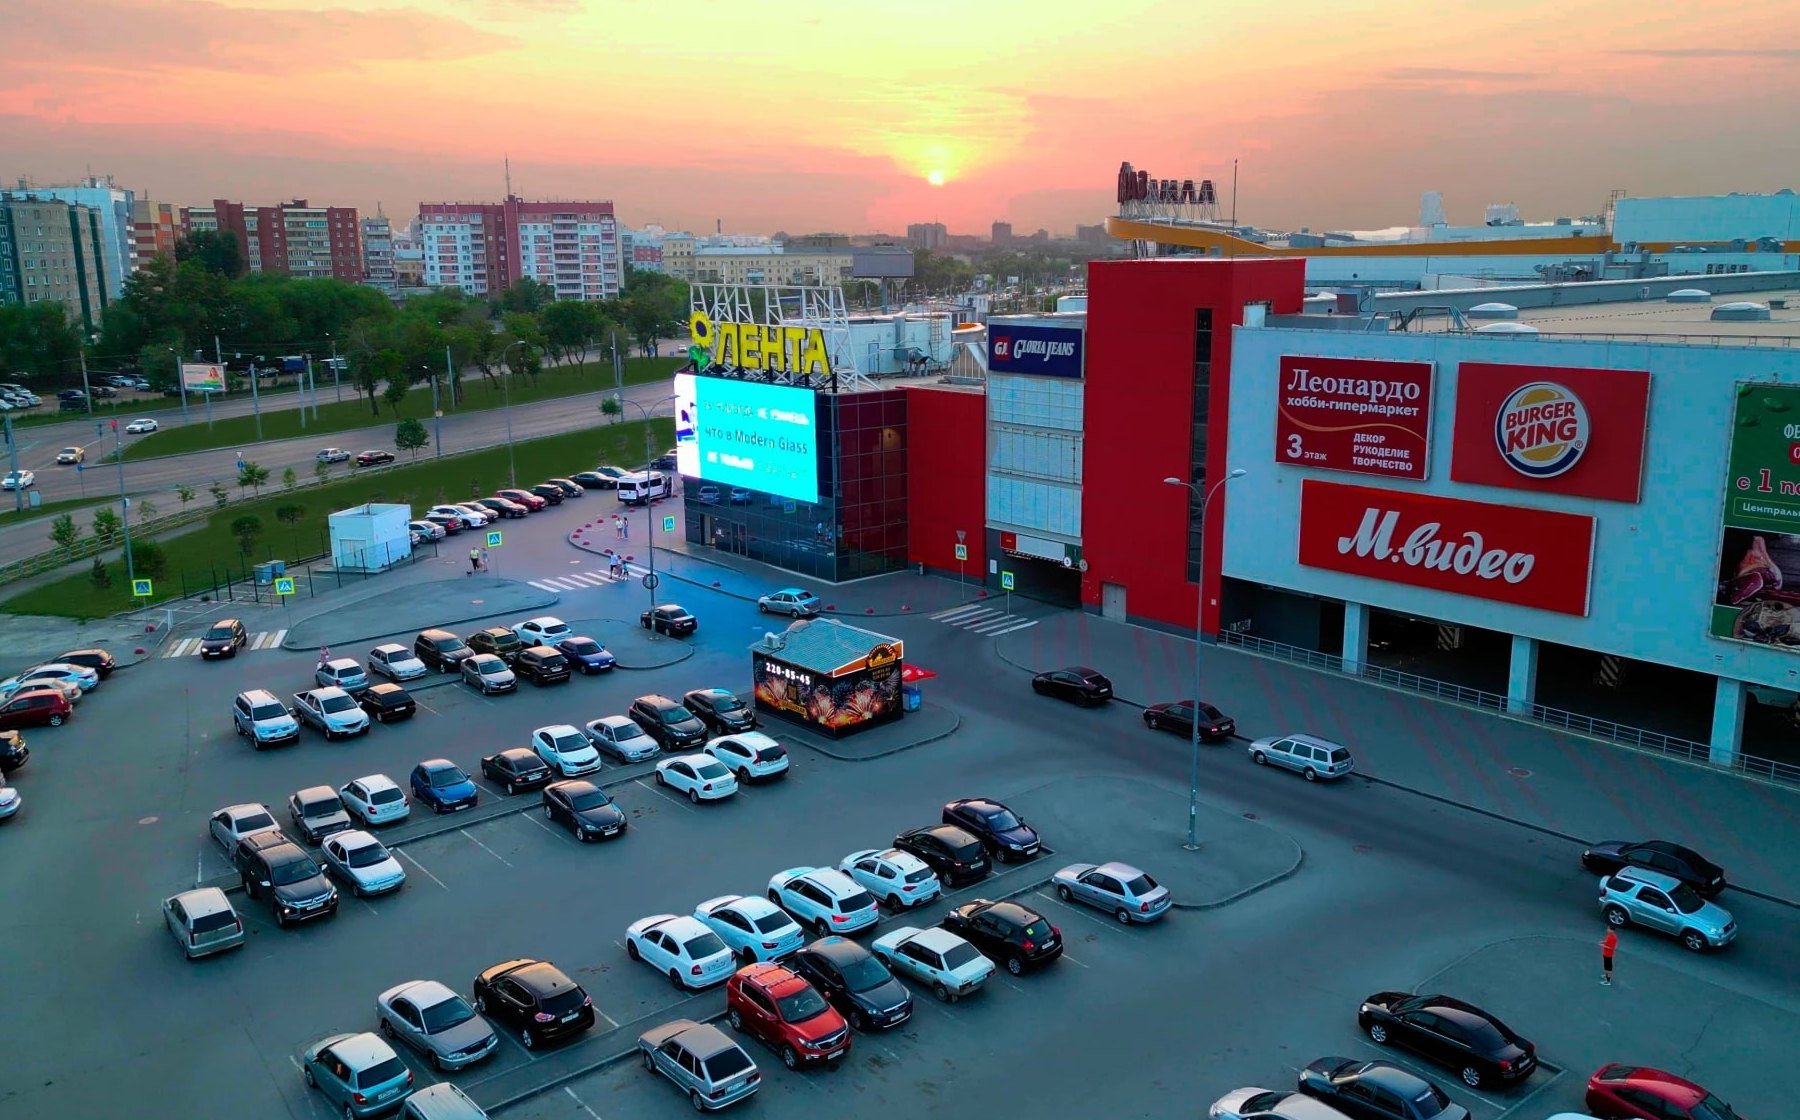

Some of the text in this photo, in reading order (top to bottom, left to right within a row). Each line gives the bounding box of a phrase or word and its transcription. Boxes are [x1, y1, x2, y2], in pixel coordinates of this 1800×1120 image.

[716, 323, 832, 376] ЛЕНТА
[1014, 339, 1046, 359] GLORIA
[1044, 341, 1076, 362] JEANS
[1287, 368, 1420, 403] Леонардо
[1287, 396, 1420, 417] хобби-гипермаркет
[1506, 401, 1576, 431] BURGER
[735, 430, 775, 448] Modern
[778, 436, 808, 455] Glass
[1286, 433, 1327, 461] 3 этаж
[1353, 433, 1386, 444] ДЕКОР
[1506, 417, 1578, 455] KING
[1352, 456, 1413, 471] ТВОРЧЕСТВО
[1353, 445, 1410, 459] РУКОДЕЛИЕ
[1736, 476, 1751, 490] с
[1757, 468, 1772, 493] 1
[1742, 502, 1800, 517] Централь
[1337, 508, 1535, 584] М.видео
[765, 662, 811, 686] 220-85-45
